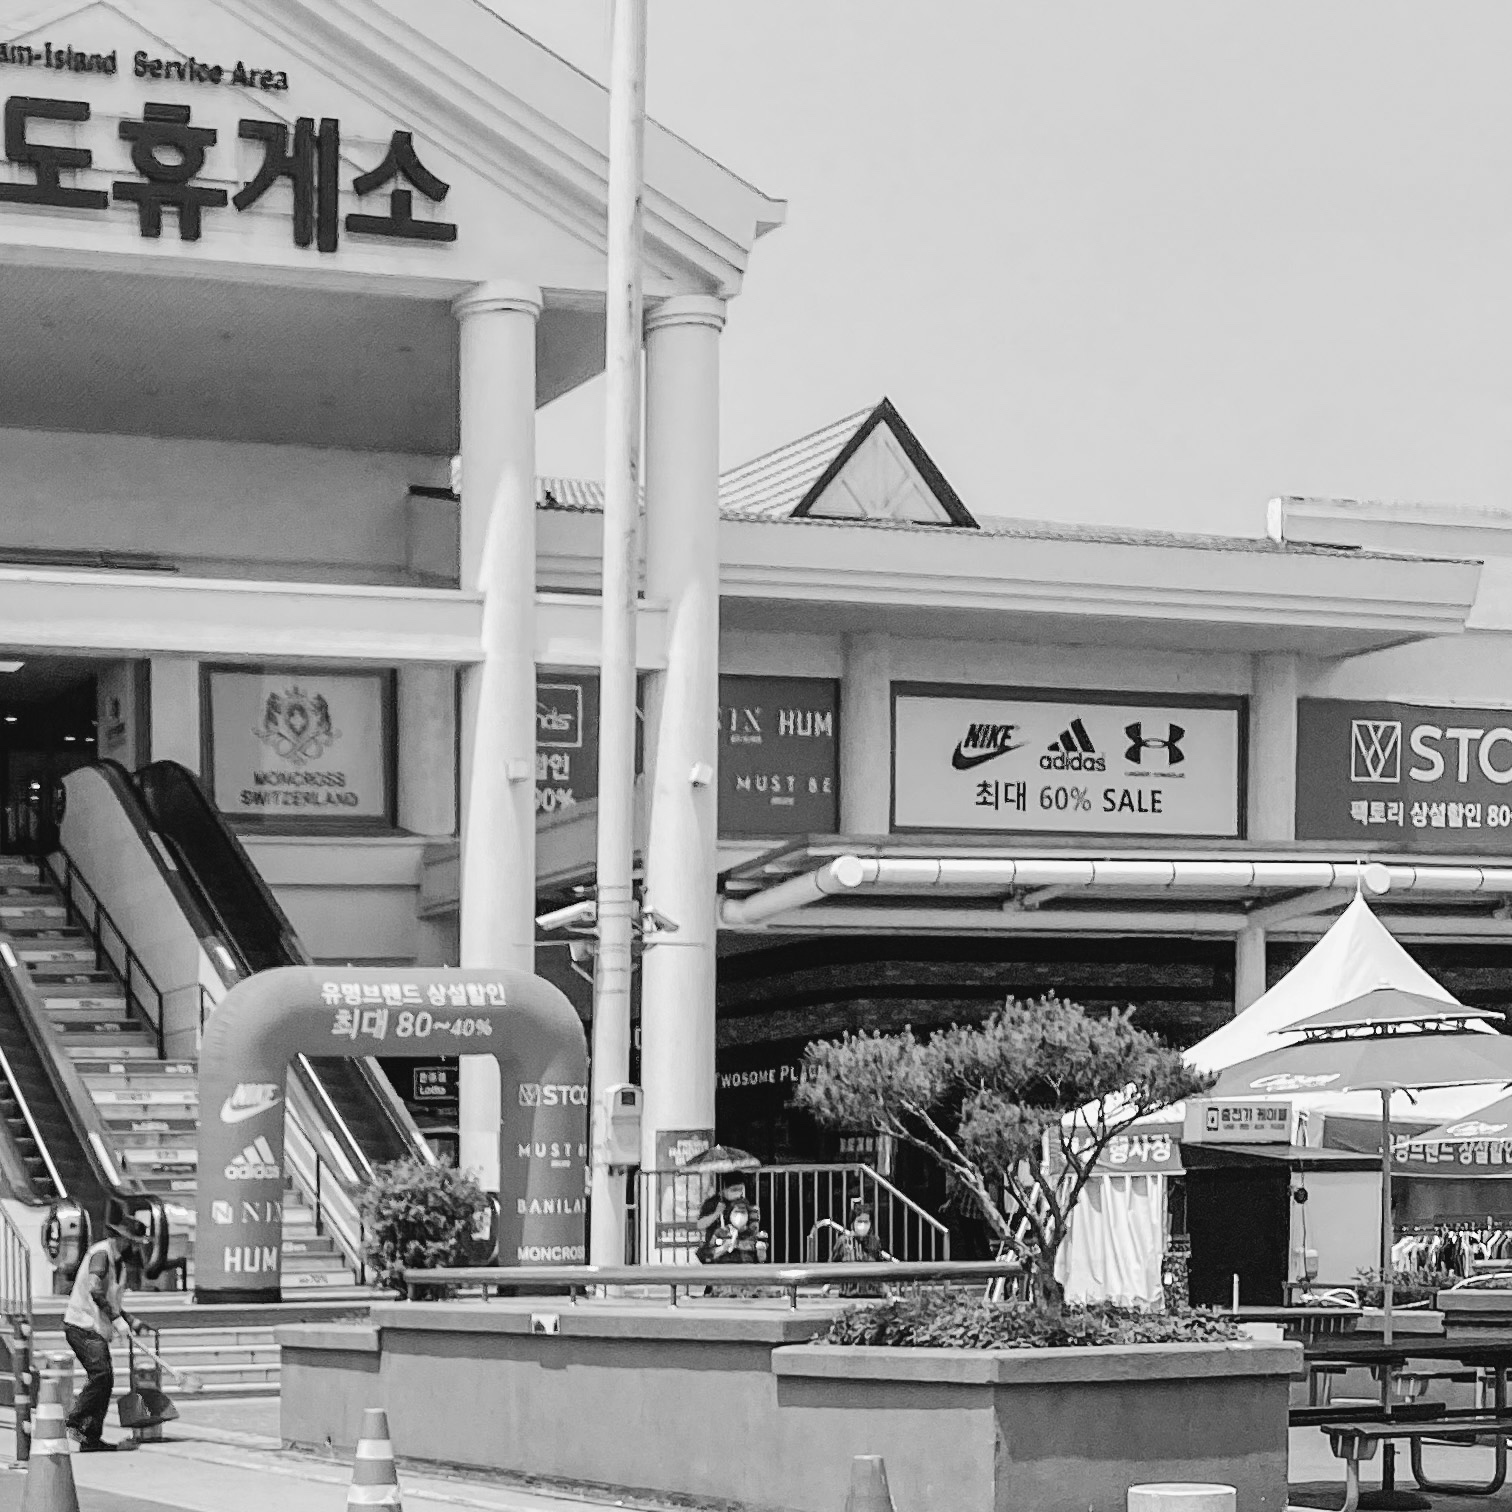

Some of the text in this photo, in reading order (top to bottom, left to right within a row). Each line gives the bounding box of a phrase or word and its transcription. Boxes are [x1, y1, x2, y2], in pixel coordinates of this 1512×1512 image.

[134, 50, 224, 84] Service
[233, 60, 288, 90] Area
[779, 709, 833, 737] HUM
[963, 723, 1015, 749] NIKE
[1039, 752, 1106, 771] adidas
[976, 780, 1163, 813] 최대 60% SALE
[1410, 802, 1482, 828] 상설할인
[320, 981, 506, 1007] 유명브랜드 상설할인
[331, 1008, 388, 1040] 최대
[224, 1246, 278, 1273] HUM
